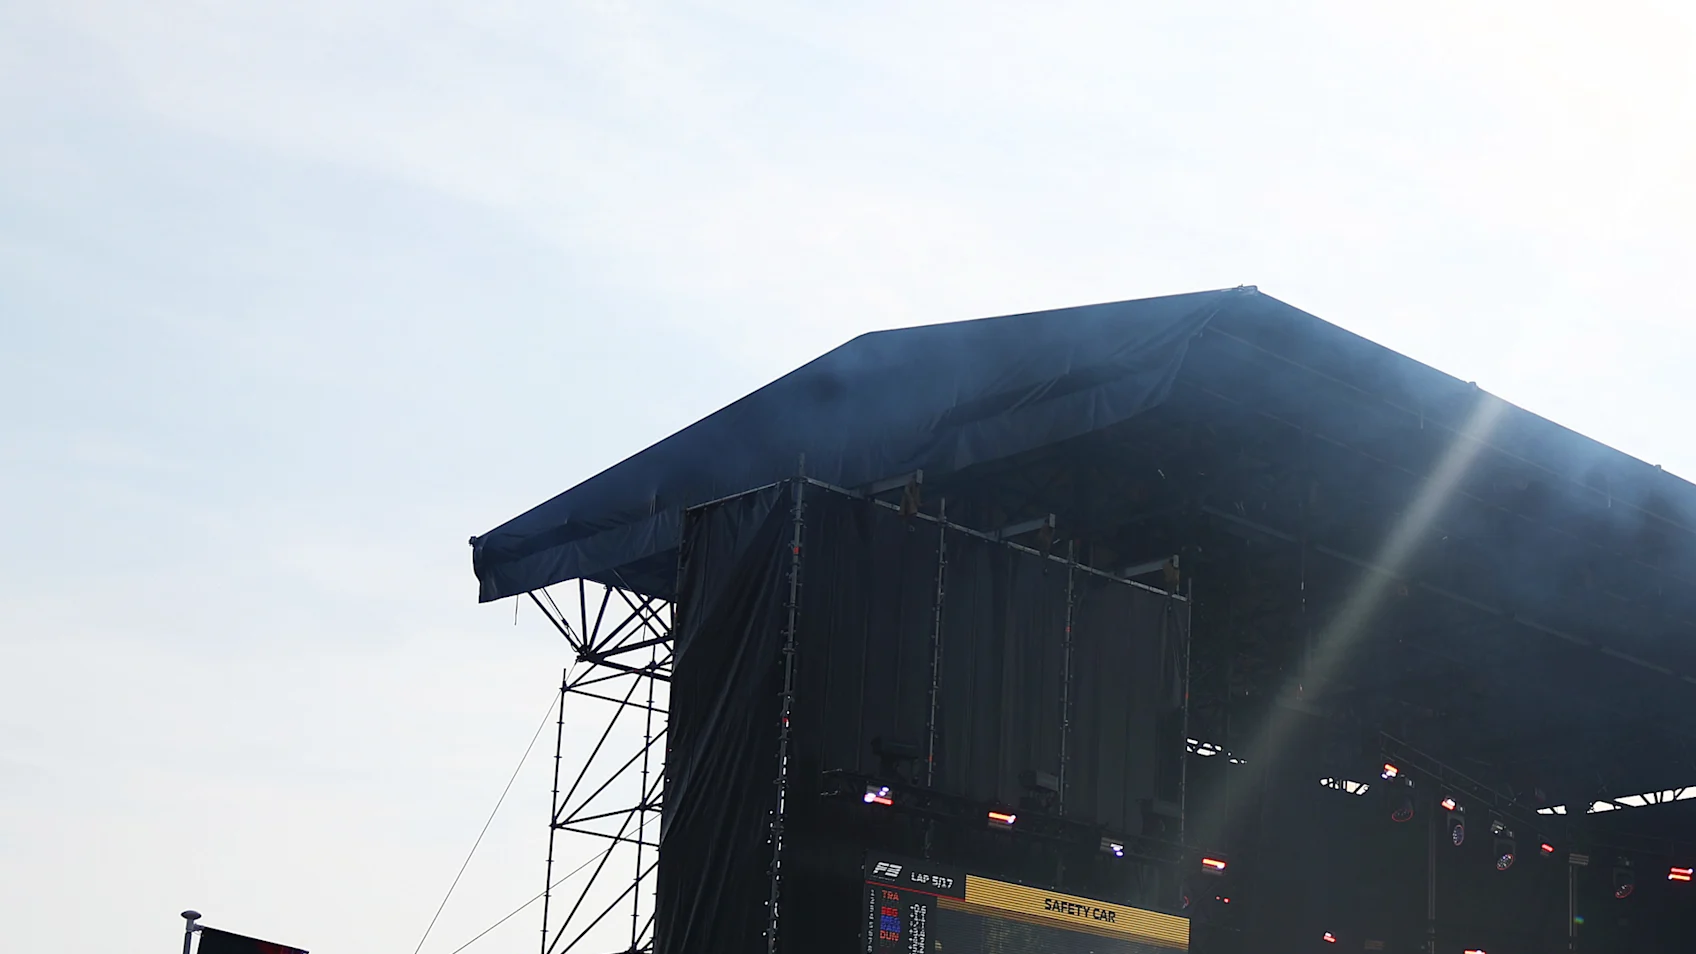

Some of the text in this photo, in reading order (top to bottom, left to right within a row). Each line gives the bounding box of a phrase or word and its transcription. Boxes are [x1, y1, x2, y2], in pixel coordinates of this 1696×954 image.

[911, 872, 930, 883] LAP
[881, 890, 899, 901] TRA
[1045, 898, 1116, 923] SAFETY CAR
